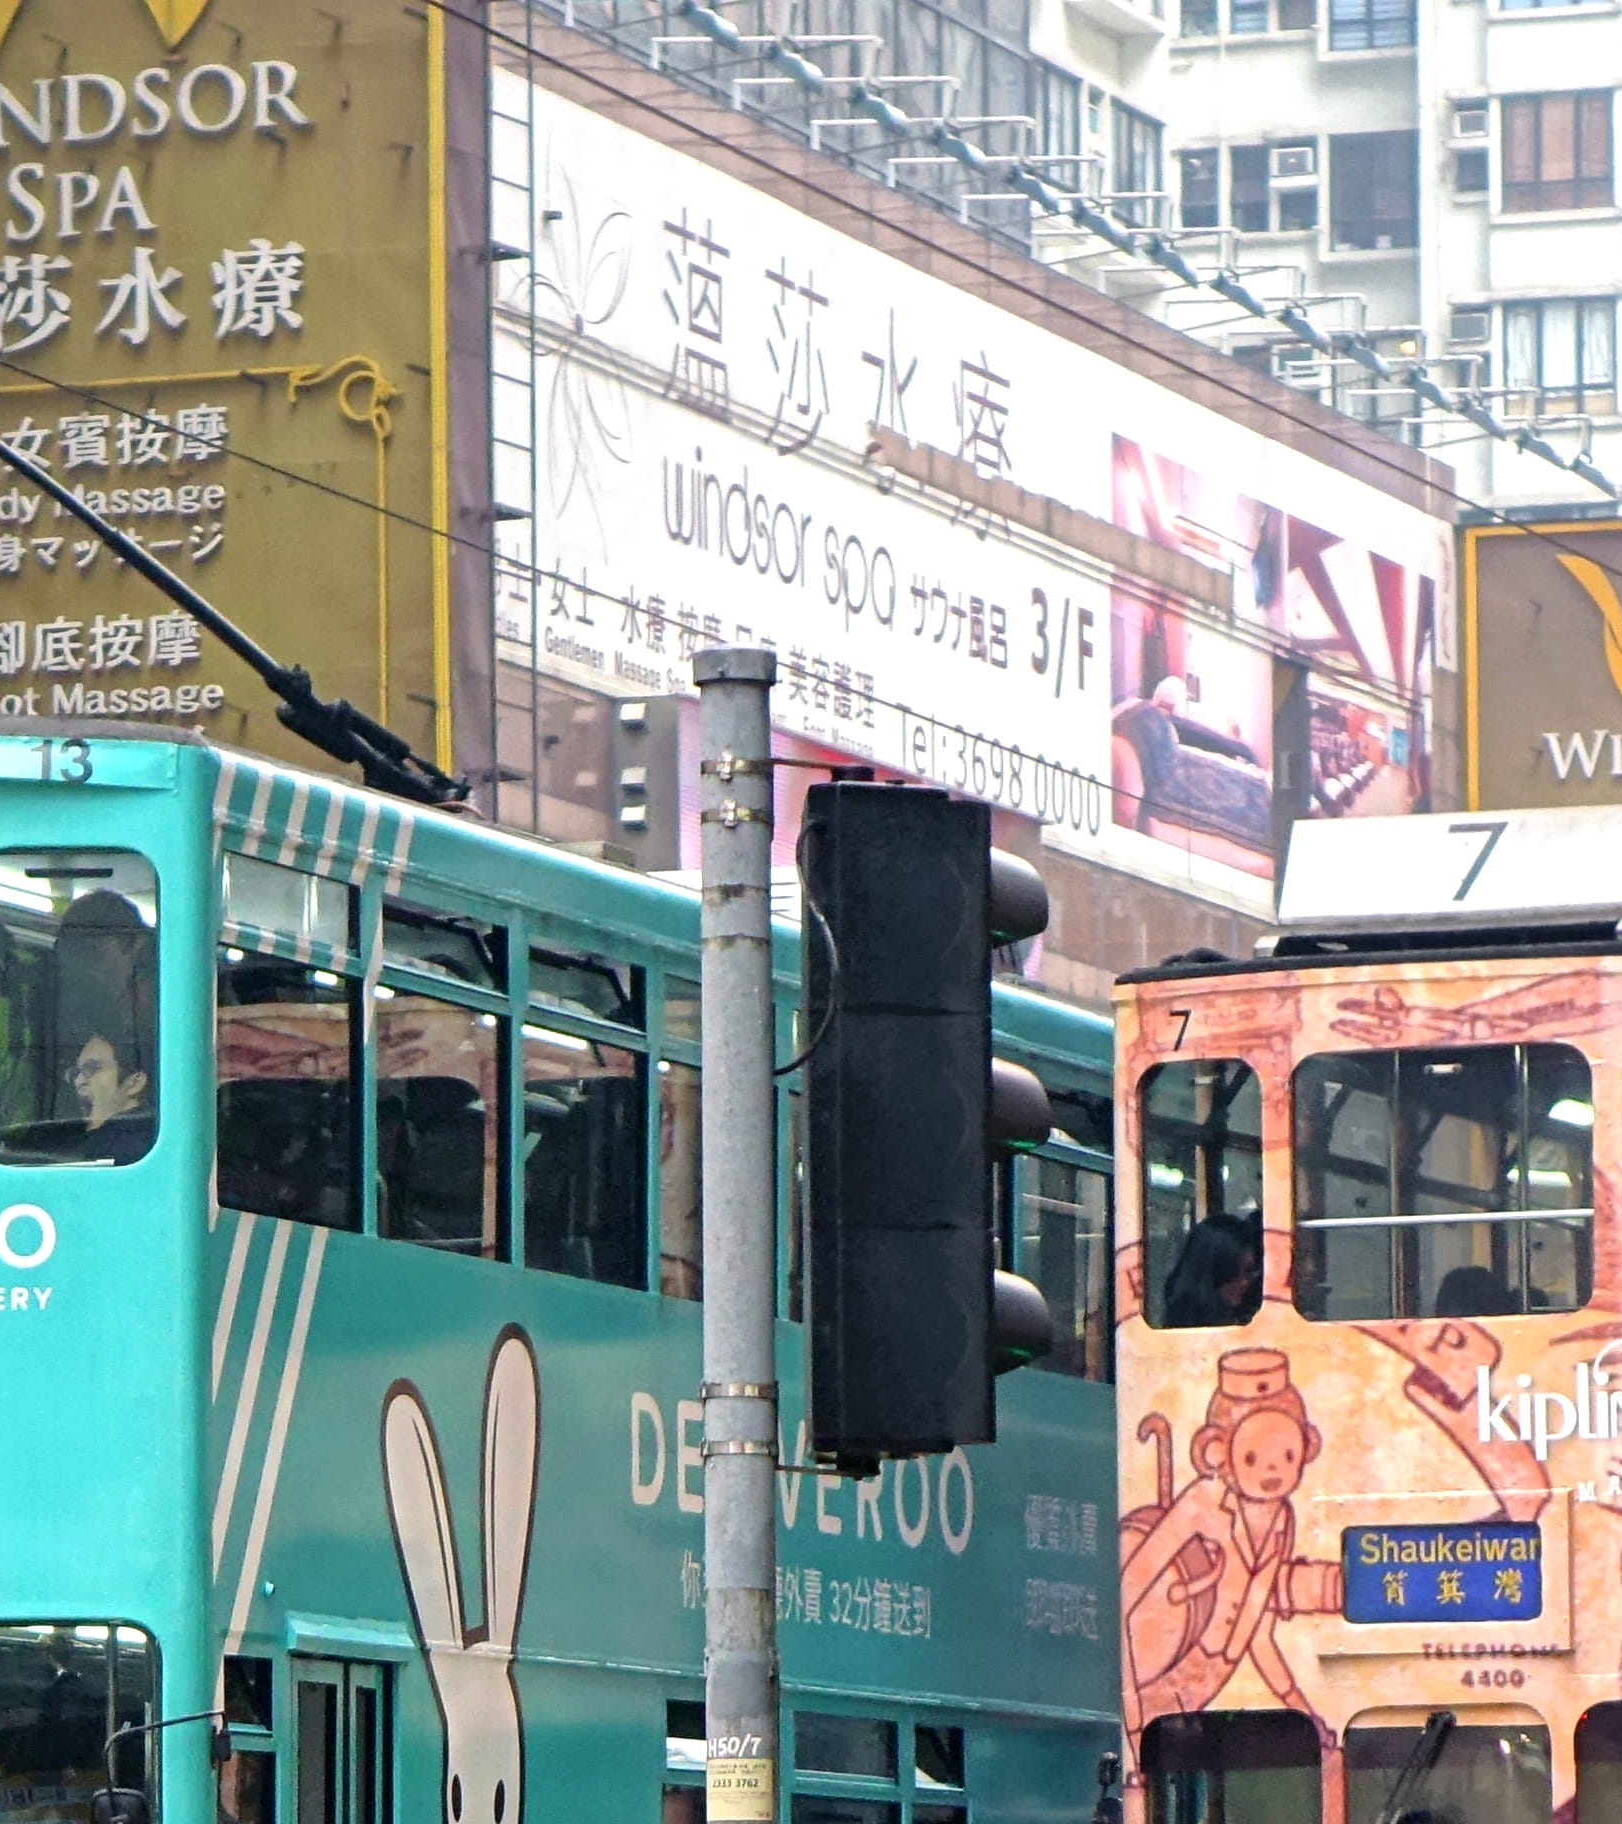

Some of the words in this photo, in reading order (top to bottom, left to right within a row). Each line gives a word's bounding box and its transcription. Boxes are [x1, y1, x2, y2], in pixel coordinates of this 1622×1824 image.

[6, 163, 157, 243] SPA
[663, 445, 812, 588] windsor
[824, 525, 896, 632] spa
[1031, 587, 1095, 698] 3/F
[52, 683, 225, 715] Massage
[32, 740, 96, 786] 13
[1448, 822, 1508, 901] 7
[1168, 1009, 1192, 1051] 7
[631, 1392, 974, 1556] DEVEROO
[1382, 1567, 1523, 1606] 筲箕灣
[1460, 1668, 1525, 1689] 4400
